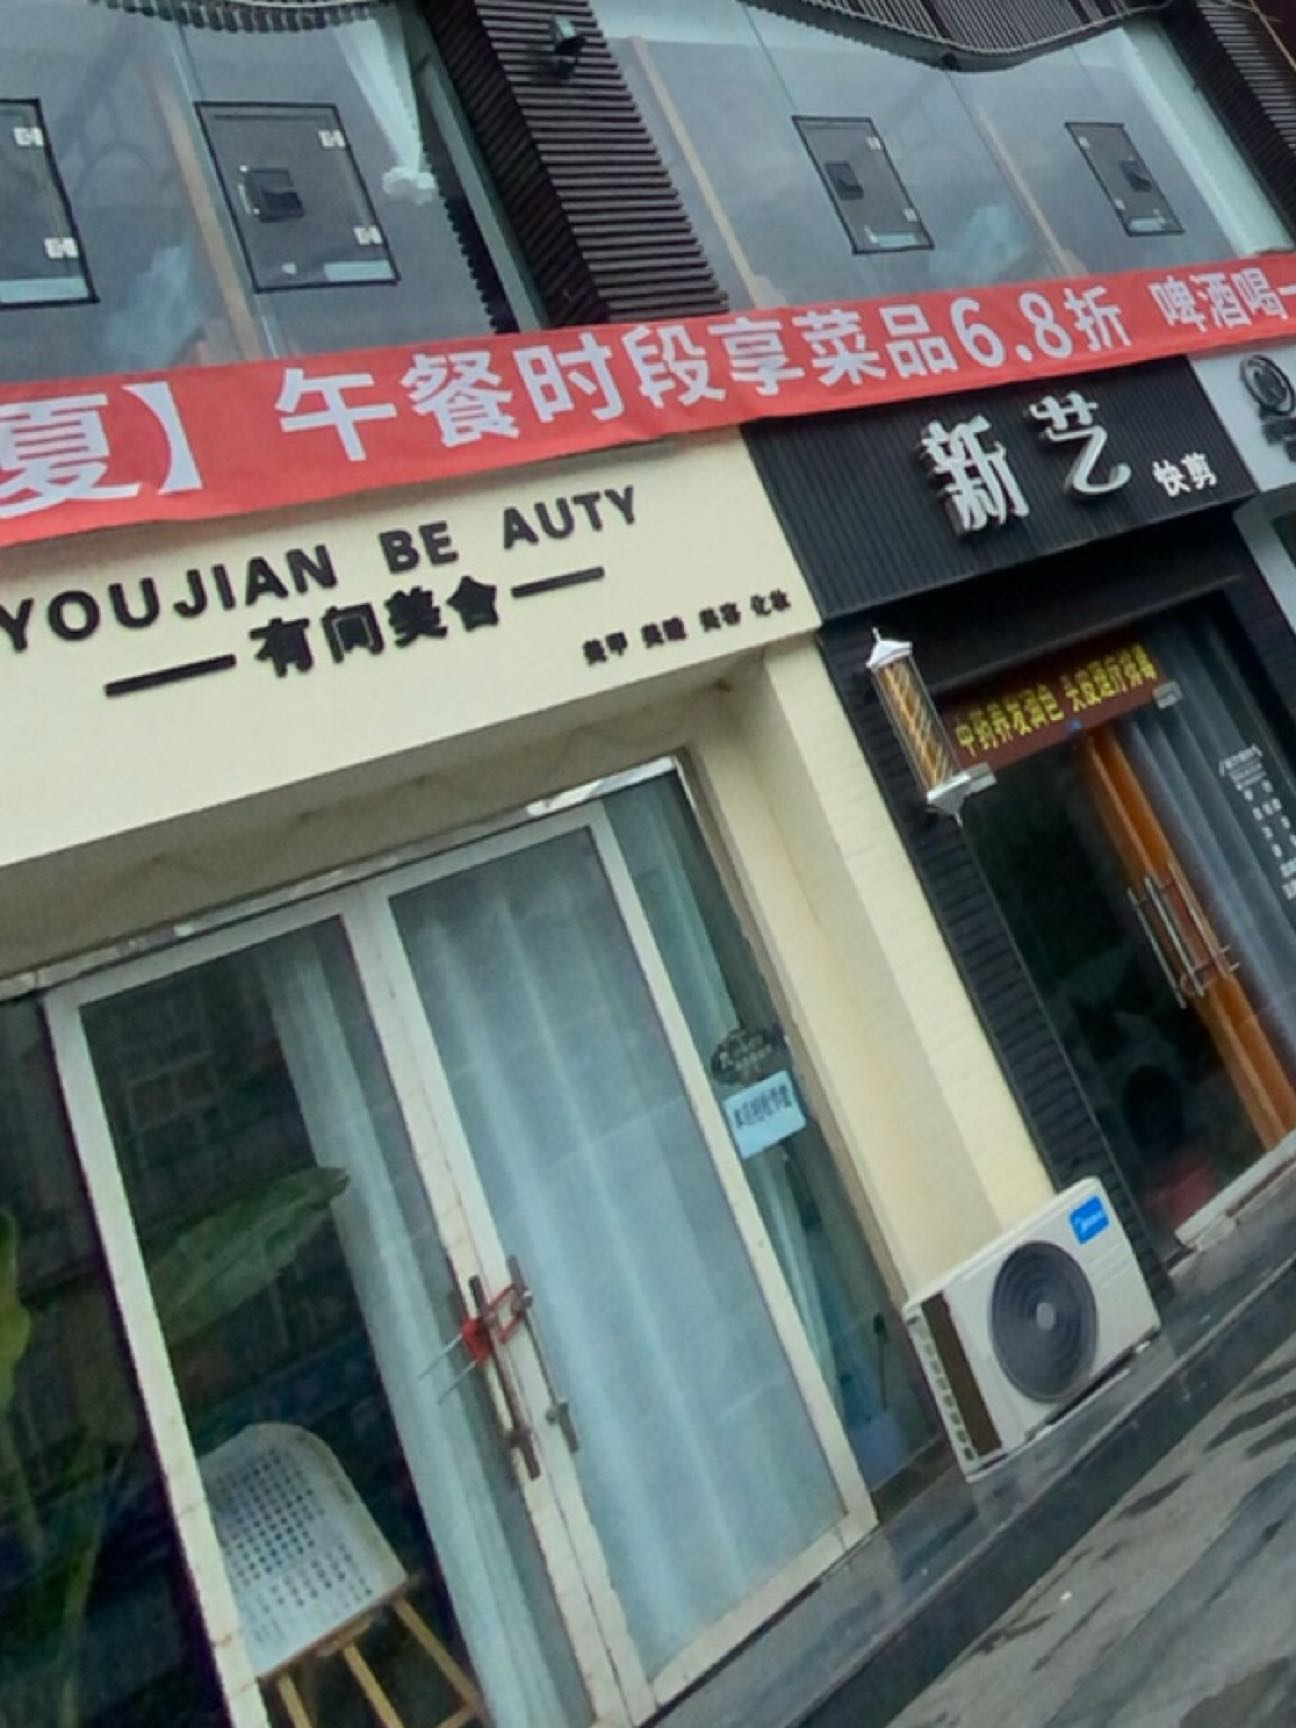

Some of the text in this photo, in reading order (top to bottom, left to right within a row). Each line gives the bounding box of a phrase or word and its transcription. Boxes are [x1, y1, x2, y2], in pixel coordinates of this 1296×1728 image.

[274, 283, 1132, 462] 午餐时段享菜品6.8折
[919, 389, 1218, 534] 新艺 快剪
[0, 484, 635, 654] YOUJIAN BE AUTY
